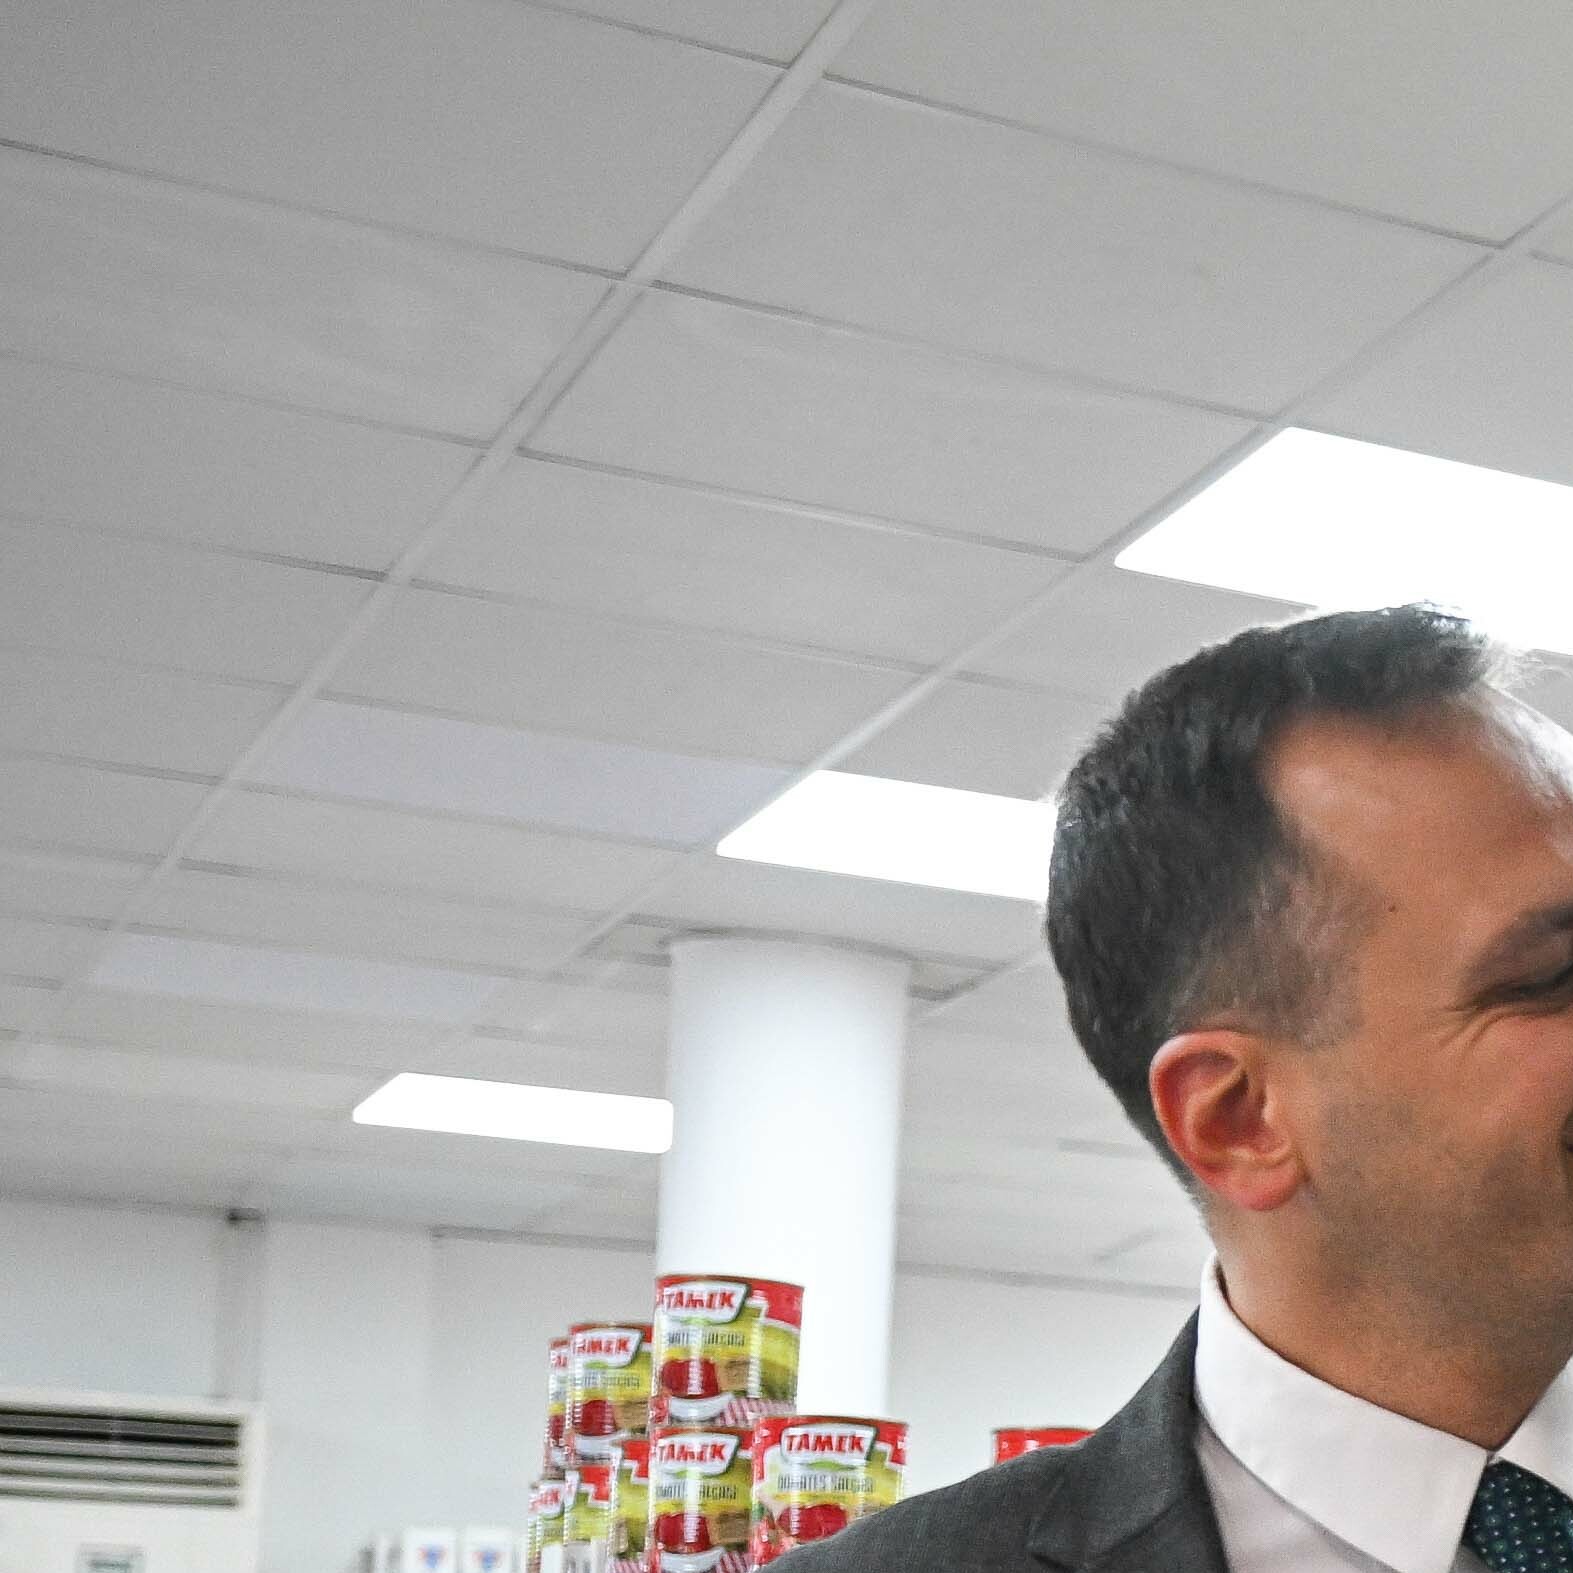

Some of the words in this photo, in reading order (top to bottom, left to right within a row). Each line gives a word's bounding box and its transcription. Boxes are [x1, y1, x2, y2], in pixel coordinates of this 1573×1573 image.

[664, 1289, 735, 1311] TAMEK
[659, 1442, 727, 1464] TAMEK
[787, 1433, 865, 1452] TAMEK
